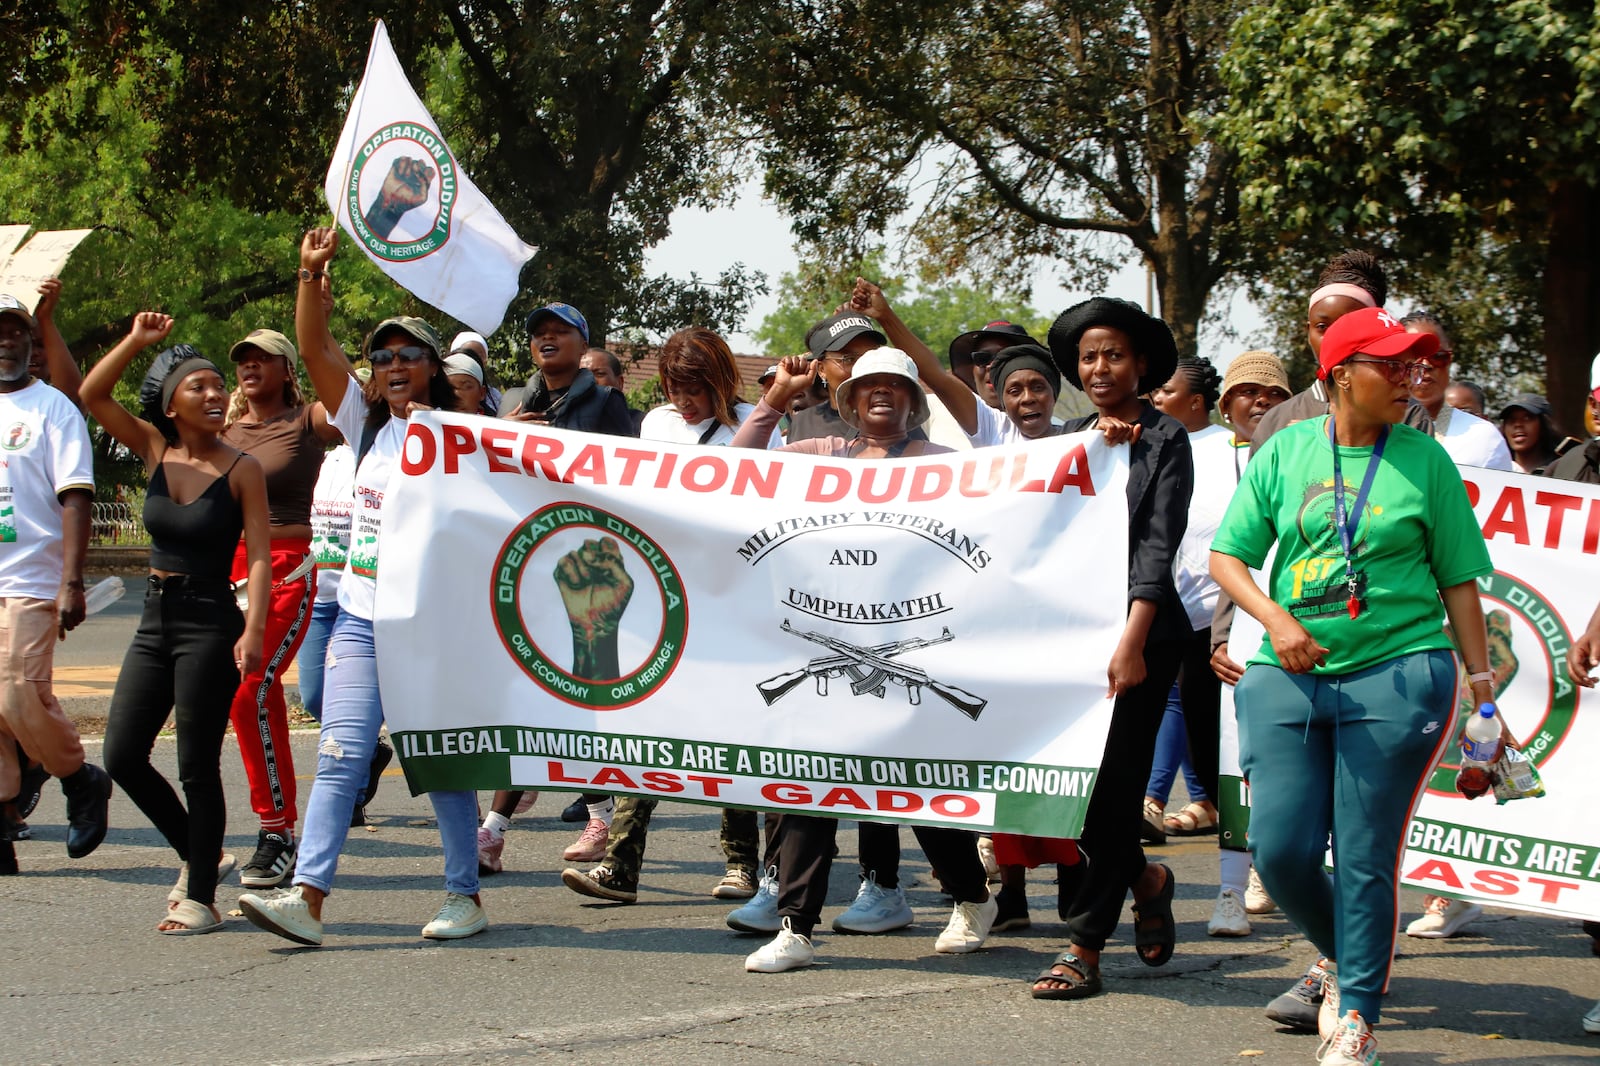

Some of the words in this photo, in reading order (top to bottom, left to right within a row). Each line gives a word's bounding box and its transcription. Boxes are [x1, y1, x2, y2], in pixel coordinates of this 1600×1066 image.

[363, 126, 444, 159] OPERATION
[351, 170, 359, 191] OUR
[351, 196, 370, 239] ECONOMY
[370, 239, 387, 255] OUR
[390, 238, 436, 257] HERITAGE
[401, 423, 784, 500] OPERATION
[805, 443, 1096, 504] DUDULA
[316, 508, 351, 517] DUDULA
[499, 508, 595, 604] OPERATION
[606, 517, 681, 612] DUDULA
[736, 511, 856, 563] MILITARY
[863, 511, 992, 570] VETERANS
[829, 549, 878, 566] AND
[1290, 557, 1335, 599] 1ST
[788, 587, 946, 620] UMPHAKATHI
[270, 645, 287, 667] CHANEL
[1505, 586, 1572, 699] DUDULA
[512, 634, 533, 660] OUR
[532, 659, 590, 699] ECONOMY
[611, 682, 636, 699] OUR
[637, 640, 675, 688] HERITAGE
[260, 720, 270, 746] CHANEL
[268, 762, 279, 789] CHANEL
[401, 729, 511, 759] ILLEGAL
[516, 730, 674, 767] IMMIGRANTS
[681, 744, 729, 772] ARE
[735, 750, 753, 774] A
[760, 750, 867, 782] BURDEN
[870, 761, 908, 785] ON
[915, 762, 970, 789] OUR
[979, 764, 1095, 798] ECONOMY
[547, 760, 733, 798] LAST
[759, 782, 981, 818] GADO
[1407, 819, 1522, 866] GRANTS
[1524, 842, 1586, 876] ARE
[1404, 859, 1580, 905] AST
